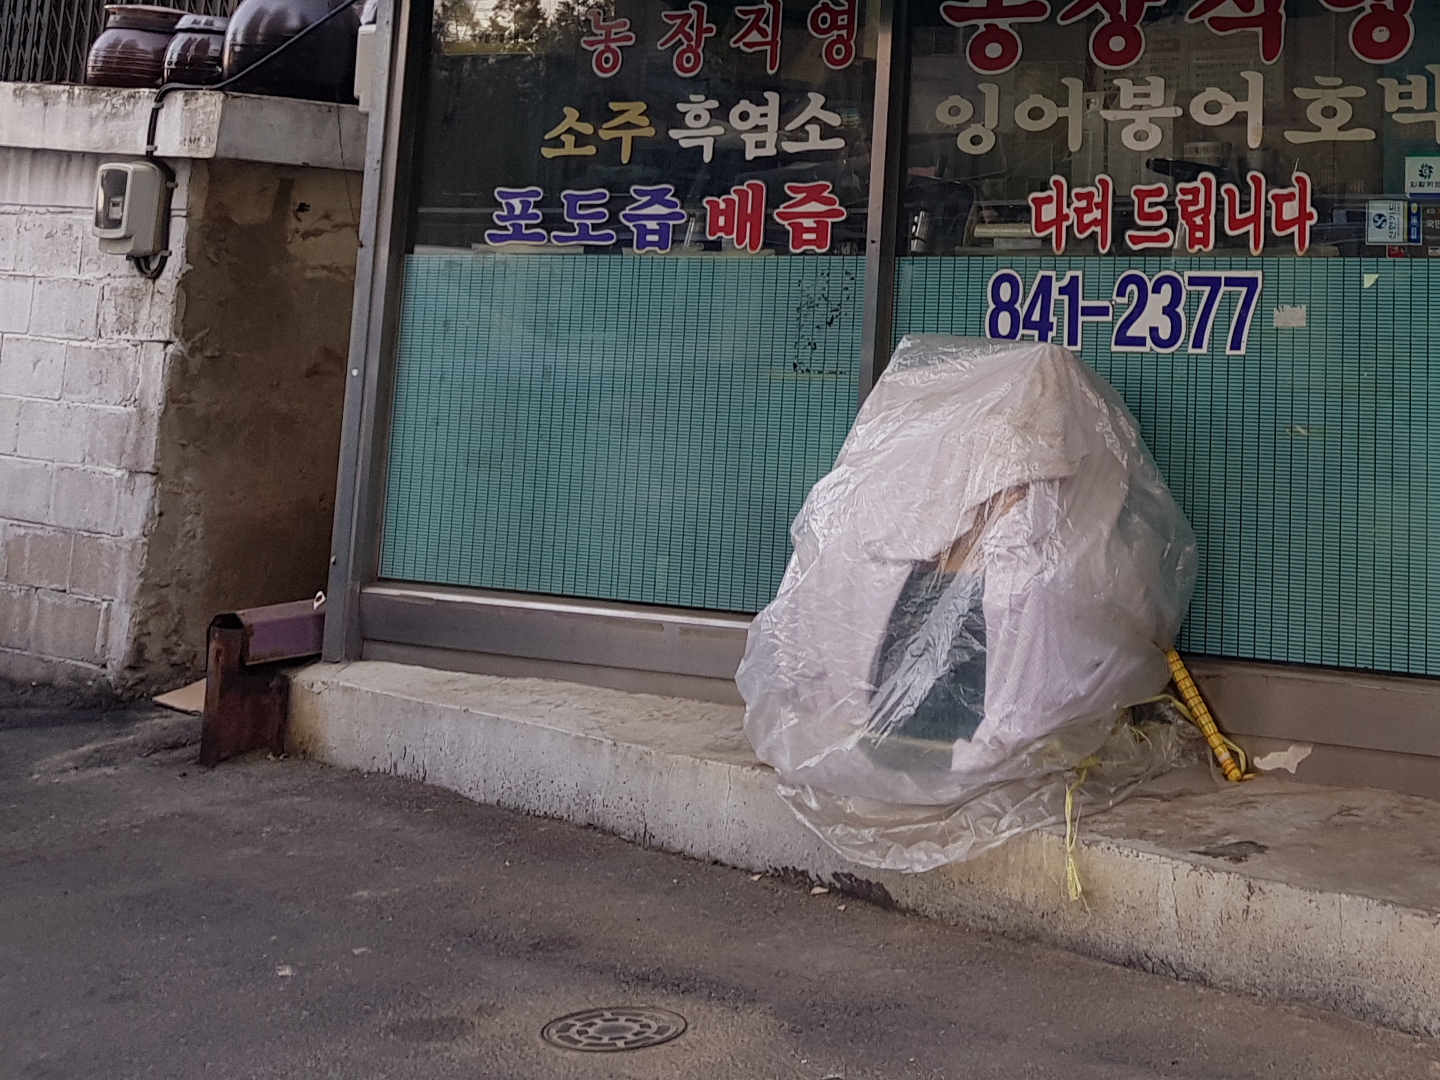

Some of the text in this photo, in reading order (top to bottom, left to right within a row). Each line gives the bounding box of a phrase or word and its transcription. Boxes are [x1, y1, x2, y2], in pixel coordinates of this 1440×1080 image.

[485, 179, 847, 255] 포도즙 배즙
[1125, 171, 1318, 257] 드립니다
[985, 268, 1263, 355] 841-2377
